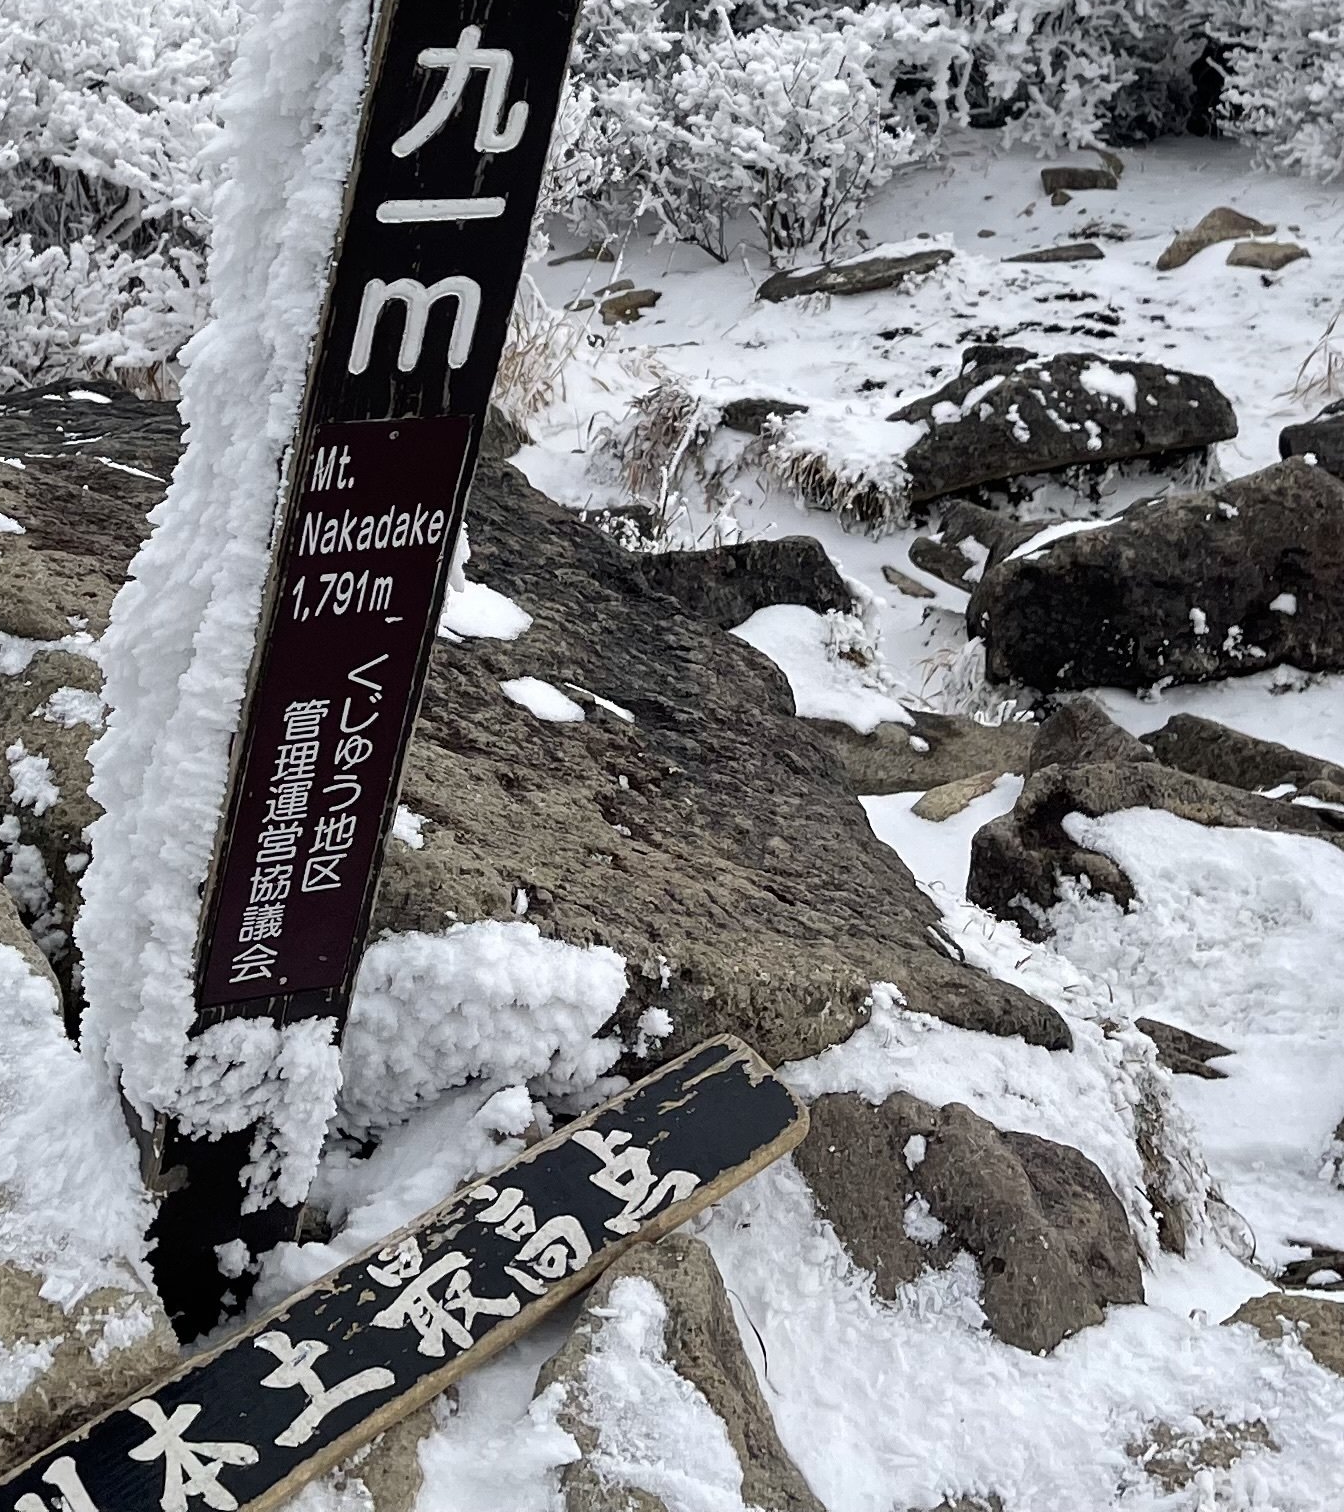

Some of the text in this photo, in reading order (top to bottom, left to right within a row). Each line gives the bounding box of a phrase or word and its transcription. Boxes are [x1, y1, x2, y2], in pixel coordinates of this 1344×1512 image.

[310, 444, 355, 492] Mt.
[298, 502, 445, 557] Nakadake
[292, 569, 394, 623] 1,791m
[301, 652, 389, 893] くじゅう地区
[228, 699, 330, 985] 管理運営協議会
